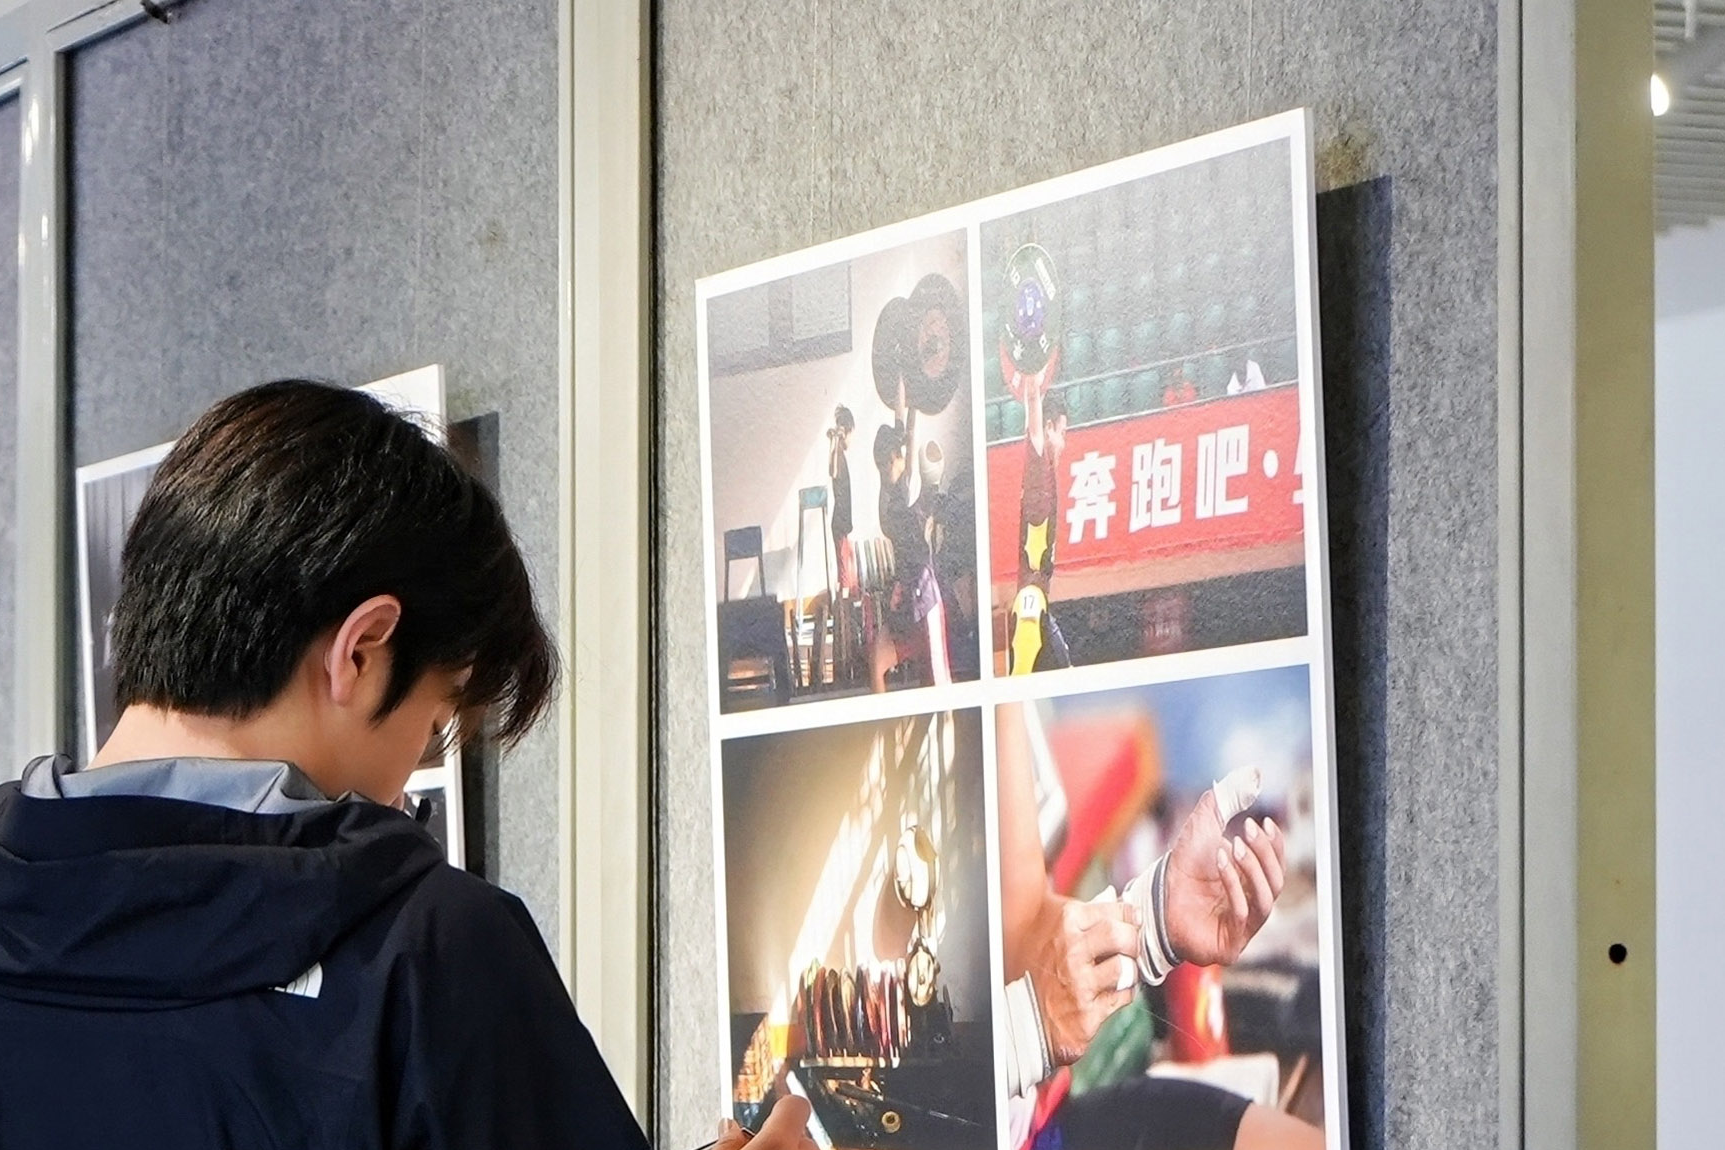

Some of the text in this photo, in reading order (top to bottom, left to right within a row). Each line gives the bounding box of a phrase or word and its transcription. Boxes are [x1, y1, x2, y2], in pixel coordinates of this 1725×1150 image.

[1065, 424, 1304, 543] 奔跑吧·
[1023, 594, 1035, 610] 17
